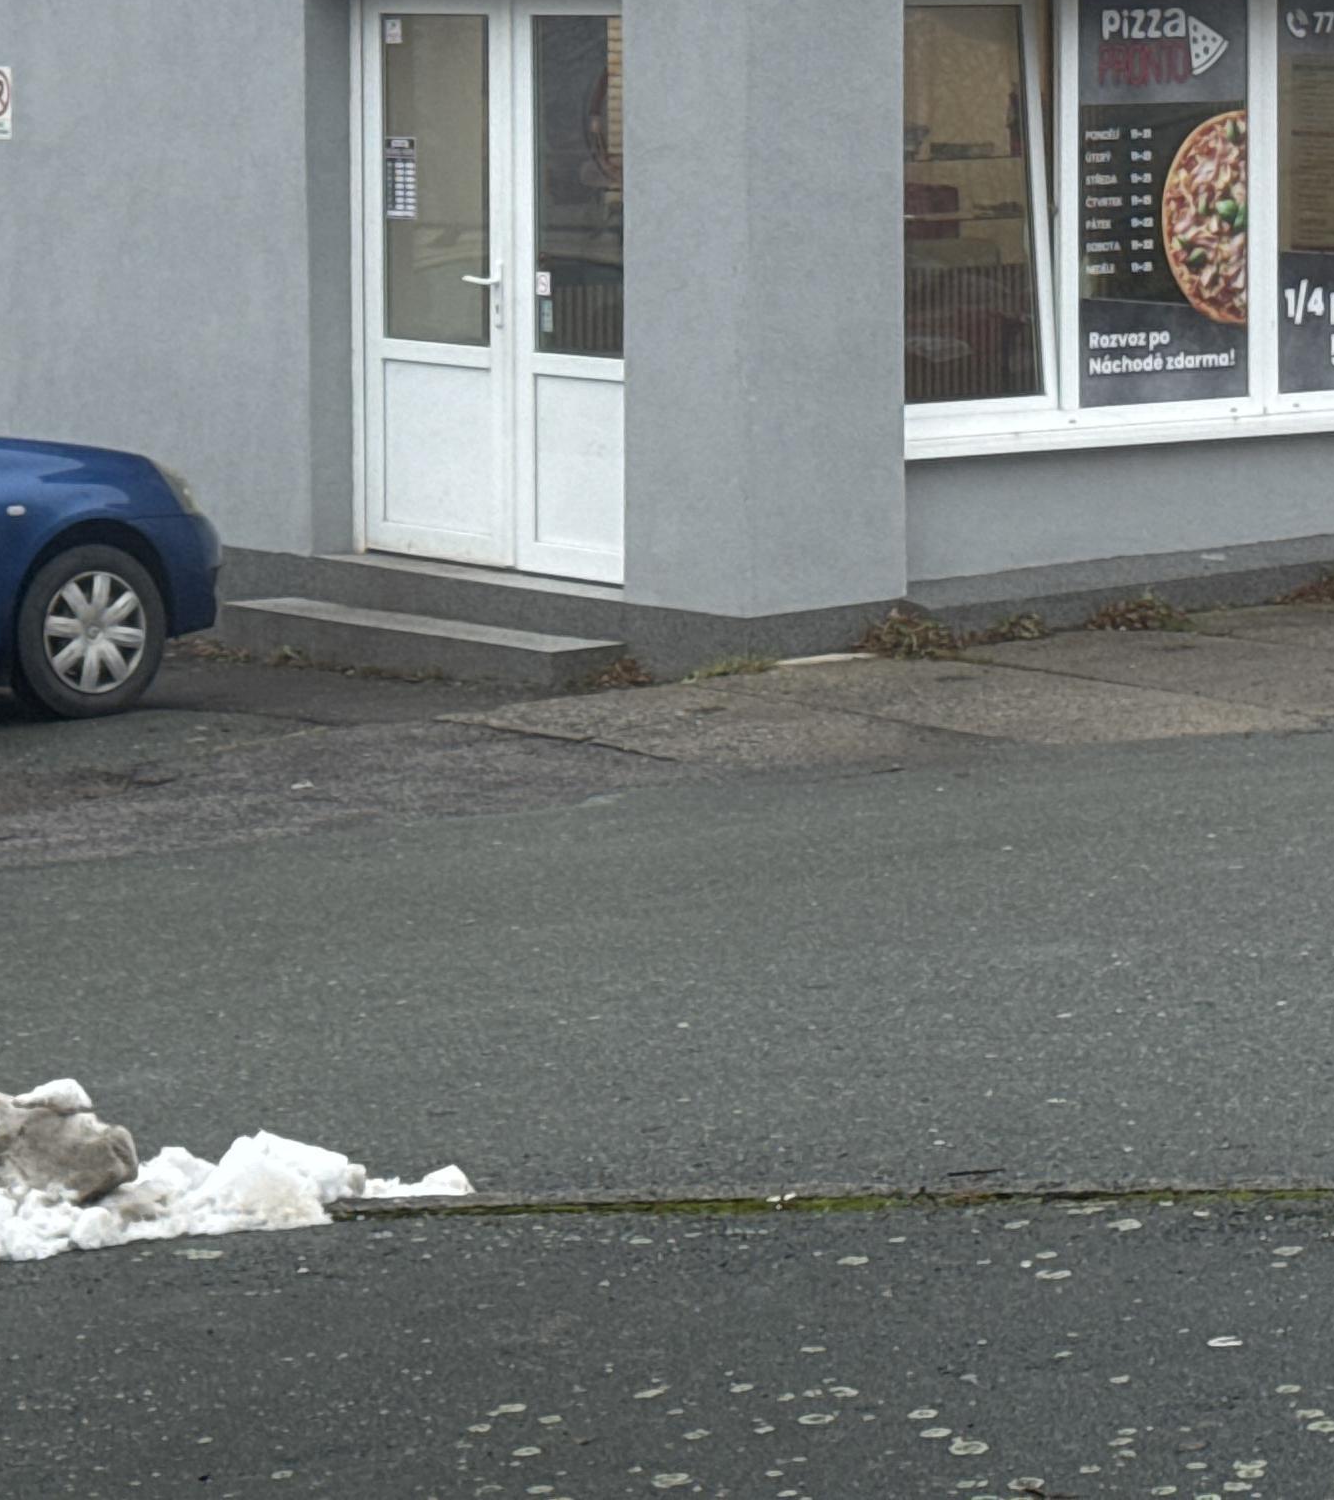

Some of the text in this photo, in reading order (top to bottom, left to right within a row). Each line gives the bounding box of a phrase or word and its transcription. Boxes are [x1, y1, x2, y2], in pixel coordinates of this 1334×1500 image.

[1101, 7, 1187, 41] pizza
[1098, 40, 1192, 87] PRONTO
[1284, 279, 1325, 325] 1/4
[1089, 330, 1170, 351] Rozvoz po
[1089, 347, 1236, 376] Náchodě zdarma!
